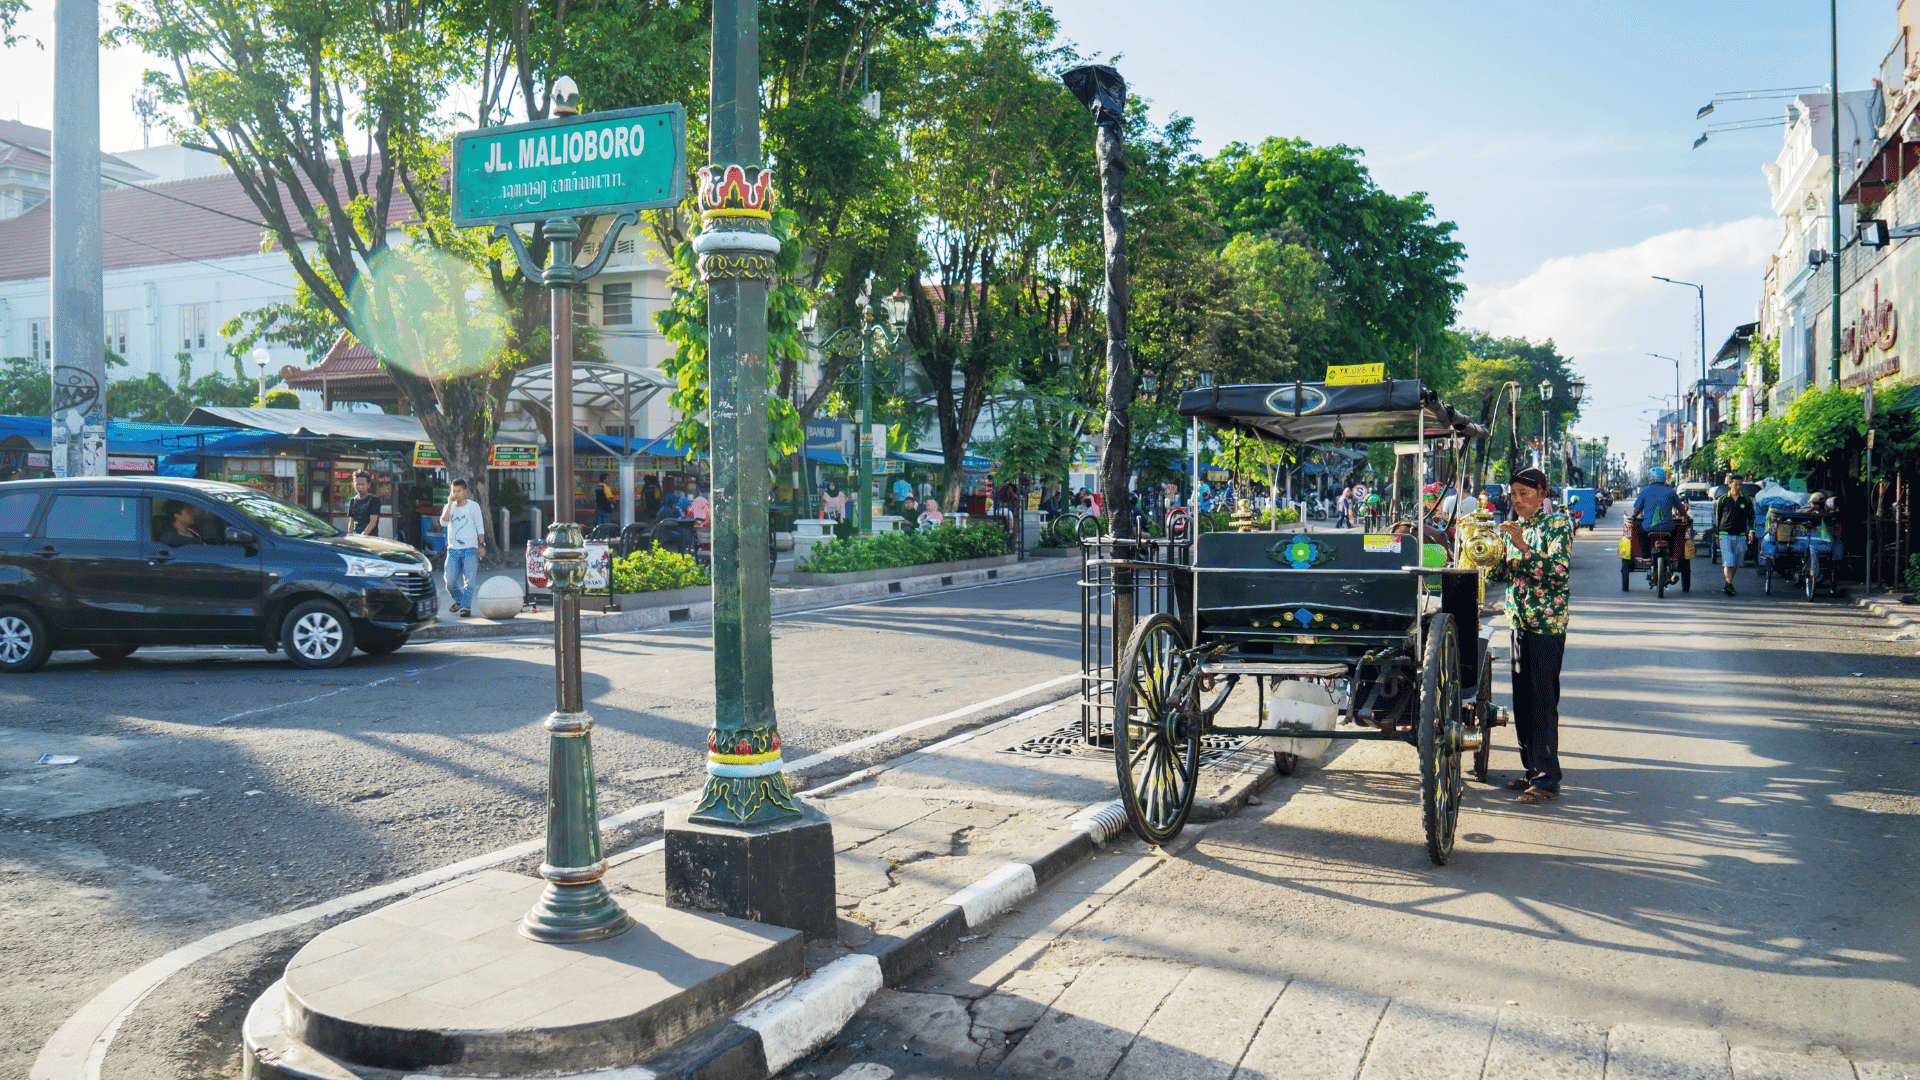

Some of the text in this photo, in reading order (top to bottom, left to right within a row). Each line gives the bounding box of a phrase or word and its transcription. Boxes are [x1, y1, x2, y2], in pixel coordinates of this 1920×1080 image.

[484, 124, 645, 173] JL. MALIOBORO
[809, 426, 826, 437] BANK
